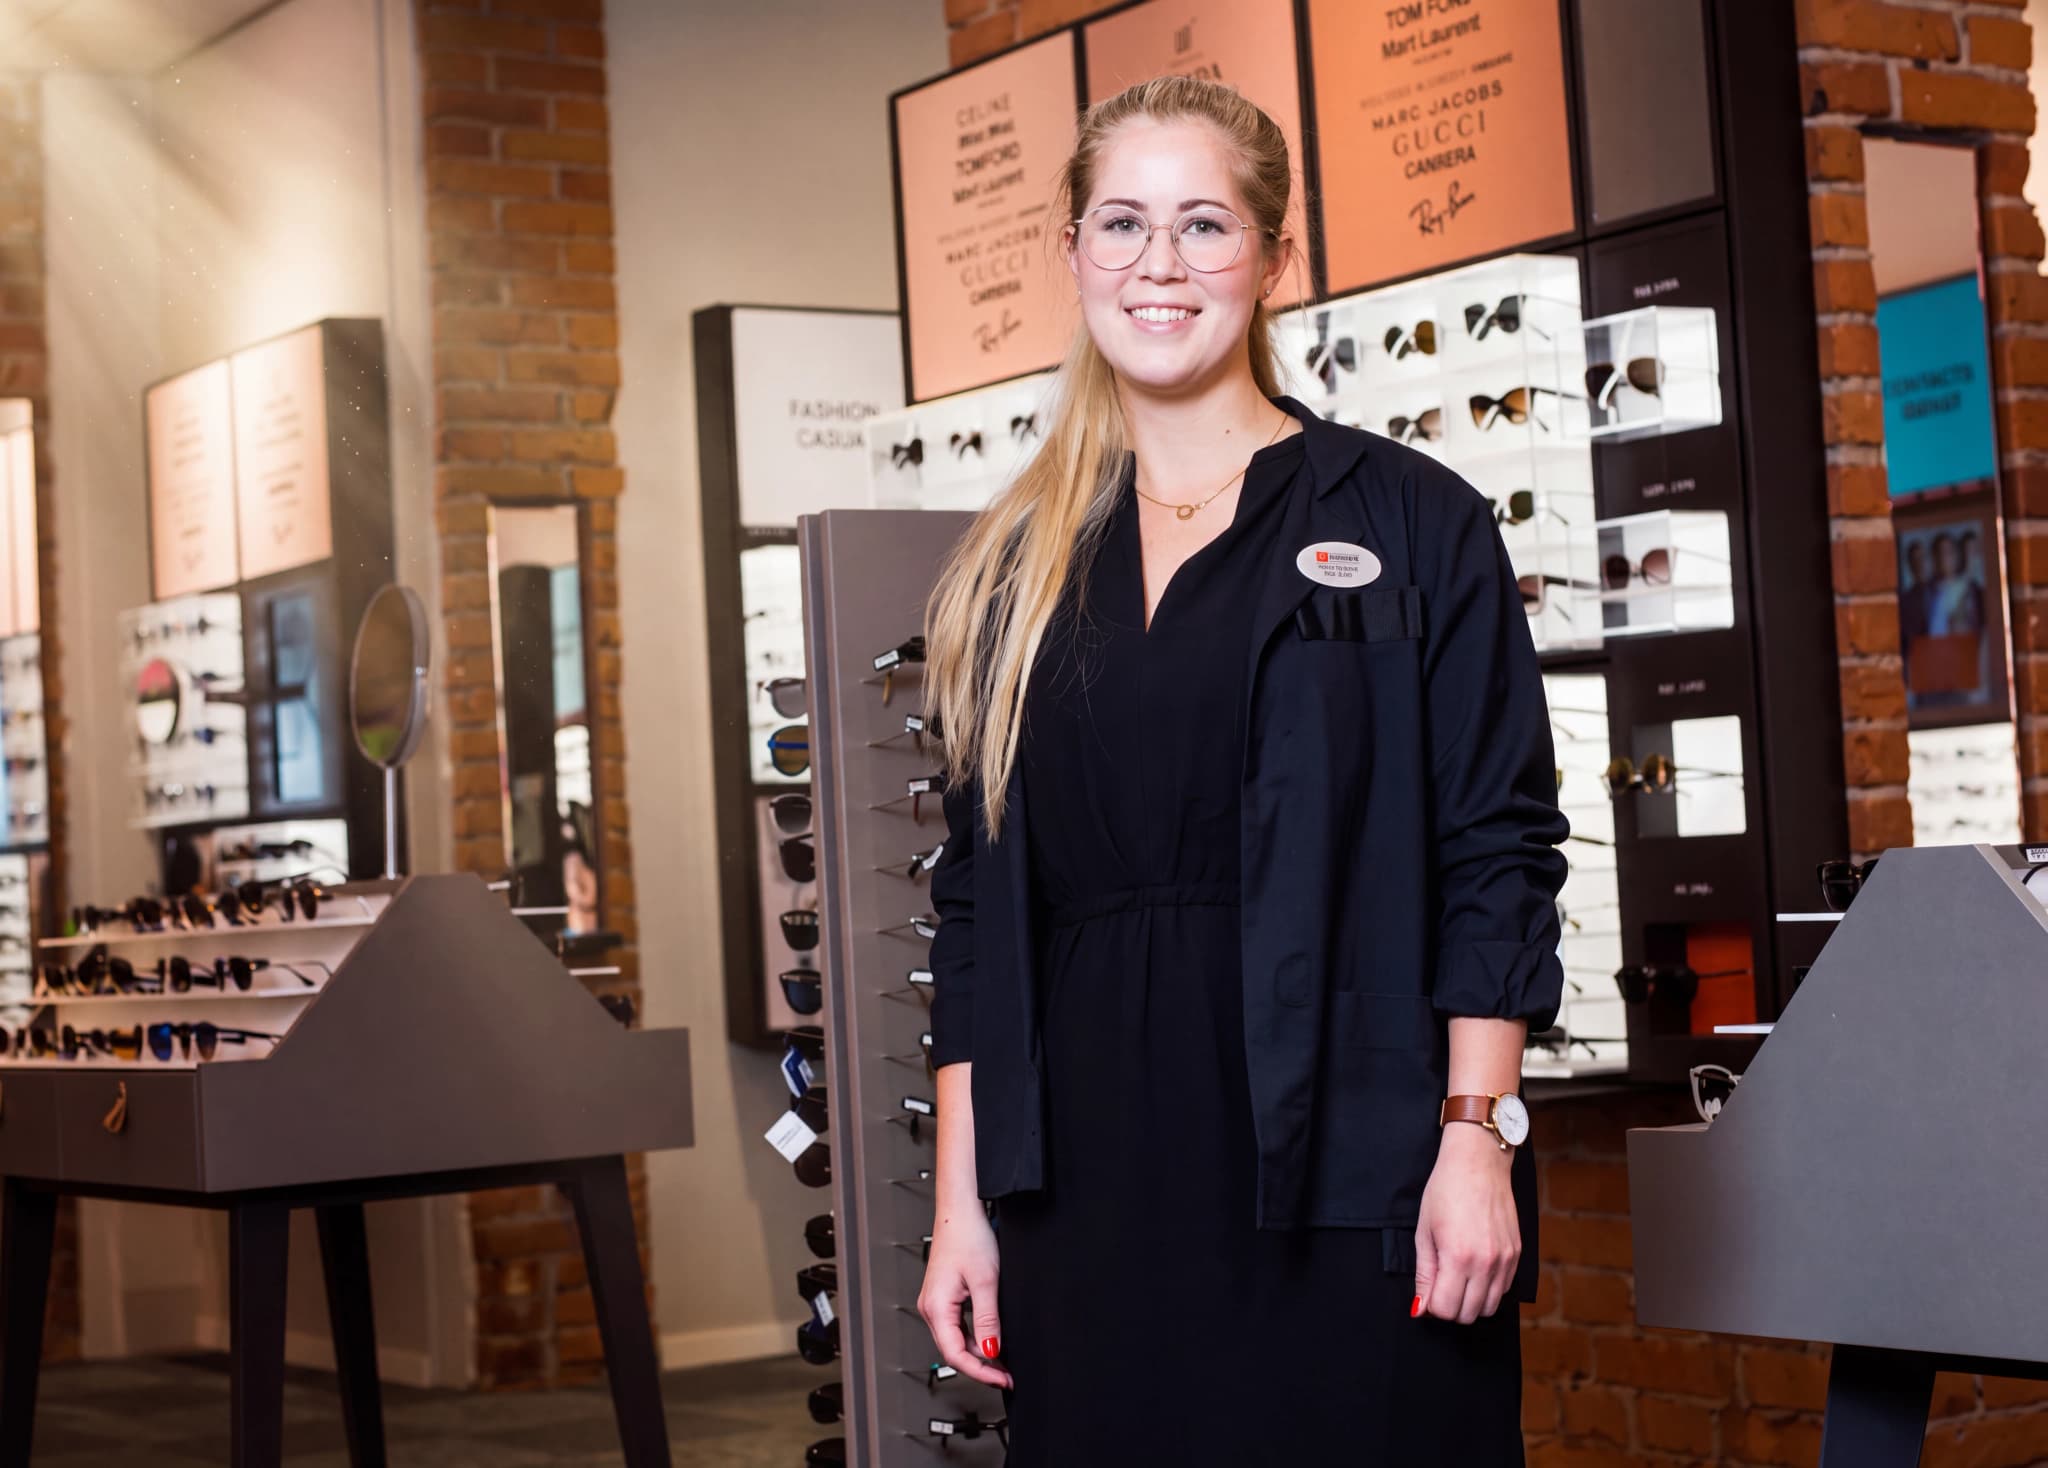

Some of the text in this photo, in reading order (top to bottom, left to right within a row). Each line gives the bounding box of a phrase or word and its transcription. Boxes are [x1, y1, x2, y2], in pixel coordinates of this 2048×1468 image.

[1427, 0, 1471, 17] FOR
[1372, 105, 1420, 130] MARC
[1428, 79, 1503, 116] JACOBS
[1393, 110, 1486, 157] GUCCI
[797, 428, 865, 449] CASUA
